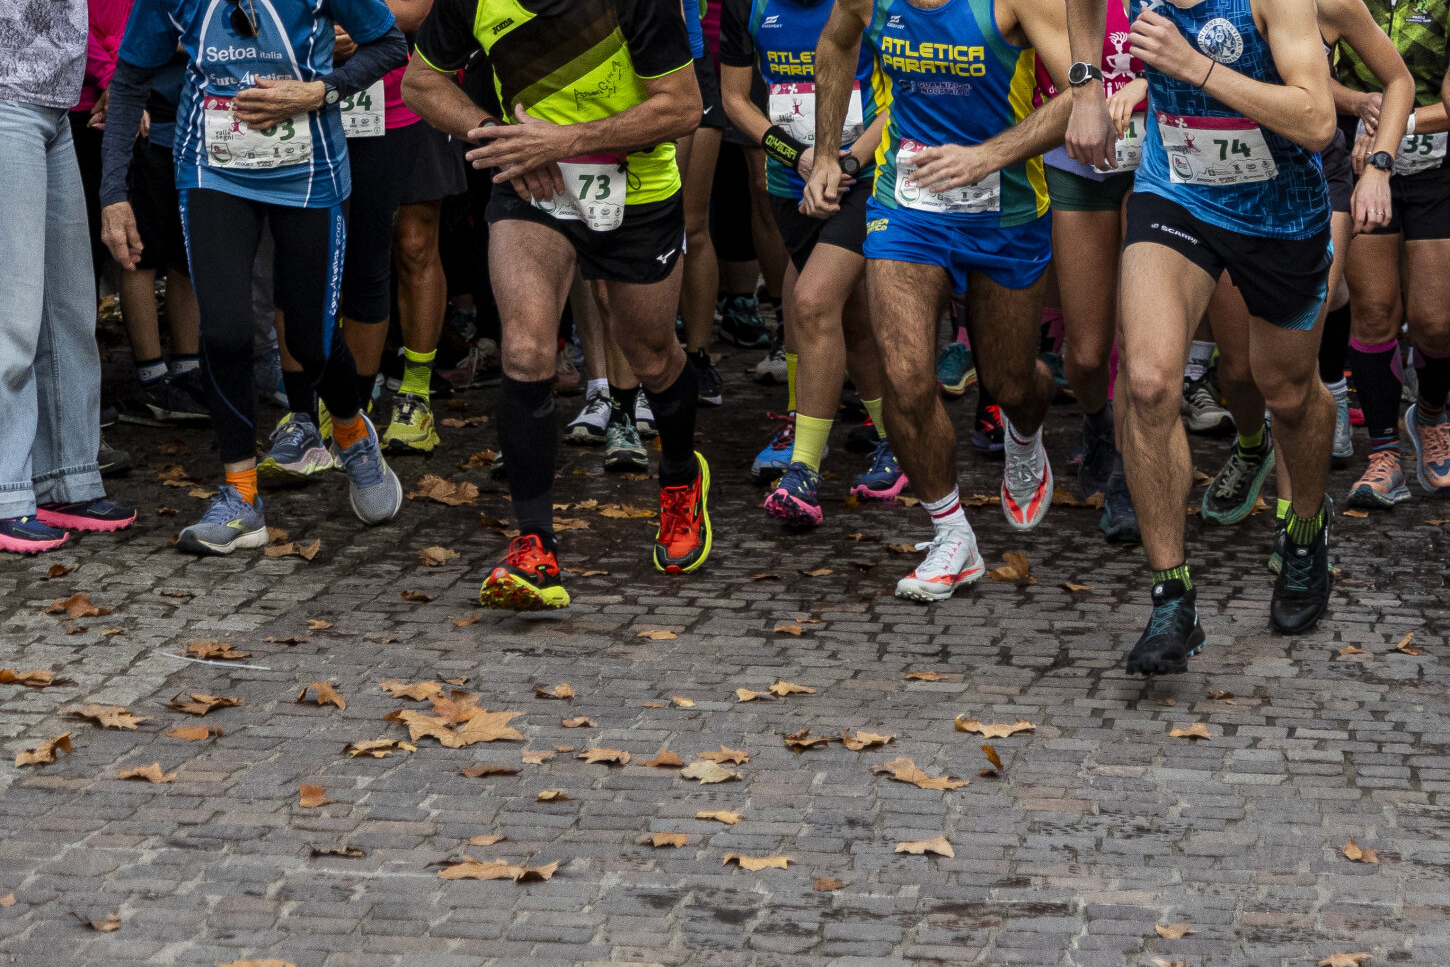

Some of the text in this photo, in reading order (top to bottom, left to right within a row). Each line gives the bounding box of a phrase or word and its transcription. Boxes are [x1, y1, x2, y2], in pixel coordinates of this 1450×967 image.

[1198, 18, 1243, 48] UNIONE SPORTIVA
[206, 45, 283, 62] Setoa italia
[881, 35, 985, 62] ATLETICA
[769, 64, 815, 76] PARA
[882, 53, 986, 77] PARATICO
[1213, 138, 1251, 161] 74
[1403, 134, 1434, 156] 35
[578, 174, 611, 201] 73
[1160, 224, 1200, 246] SCARPA
